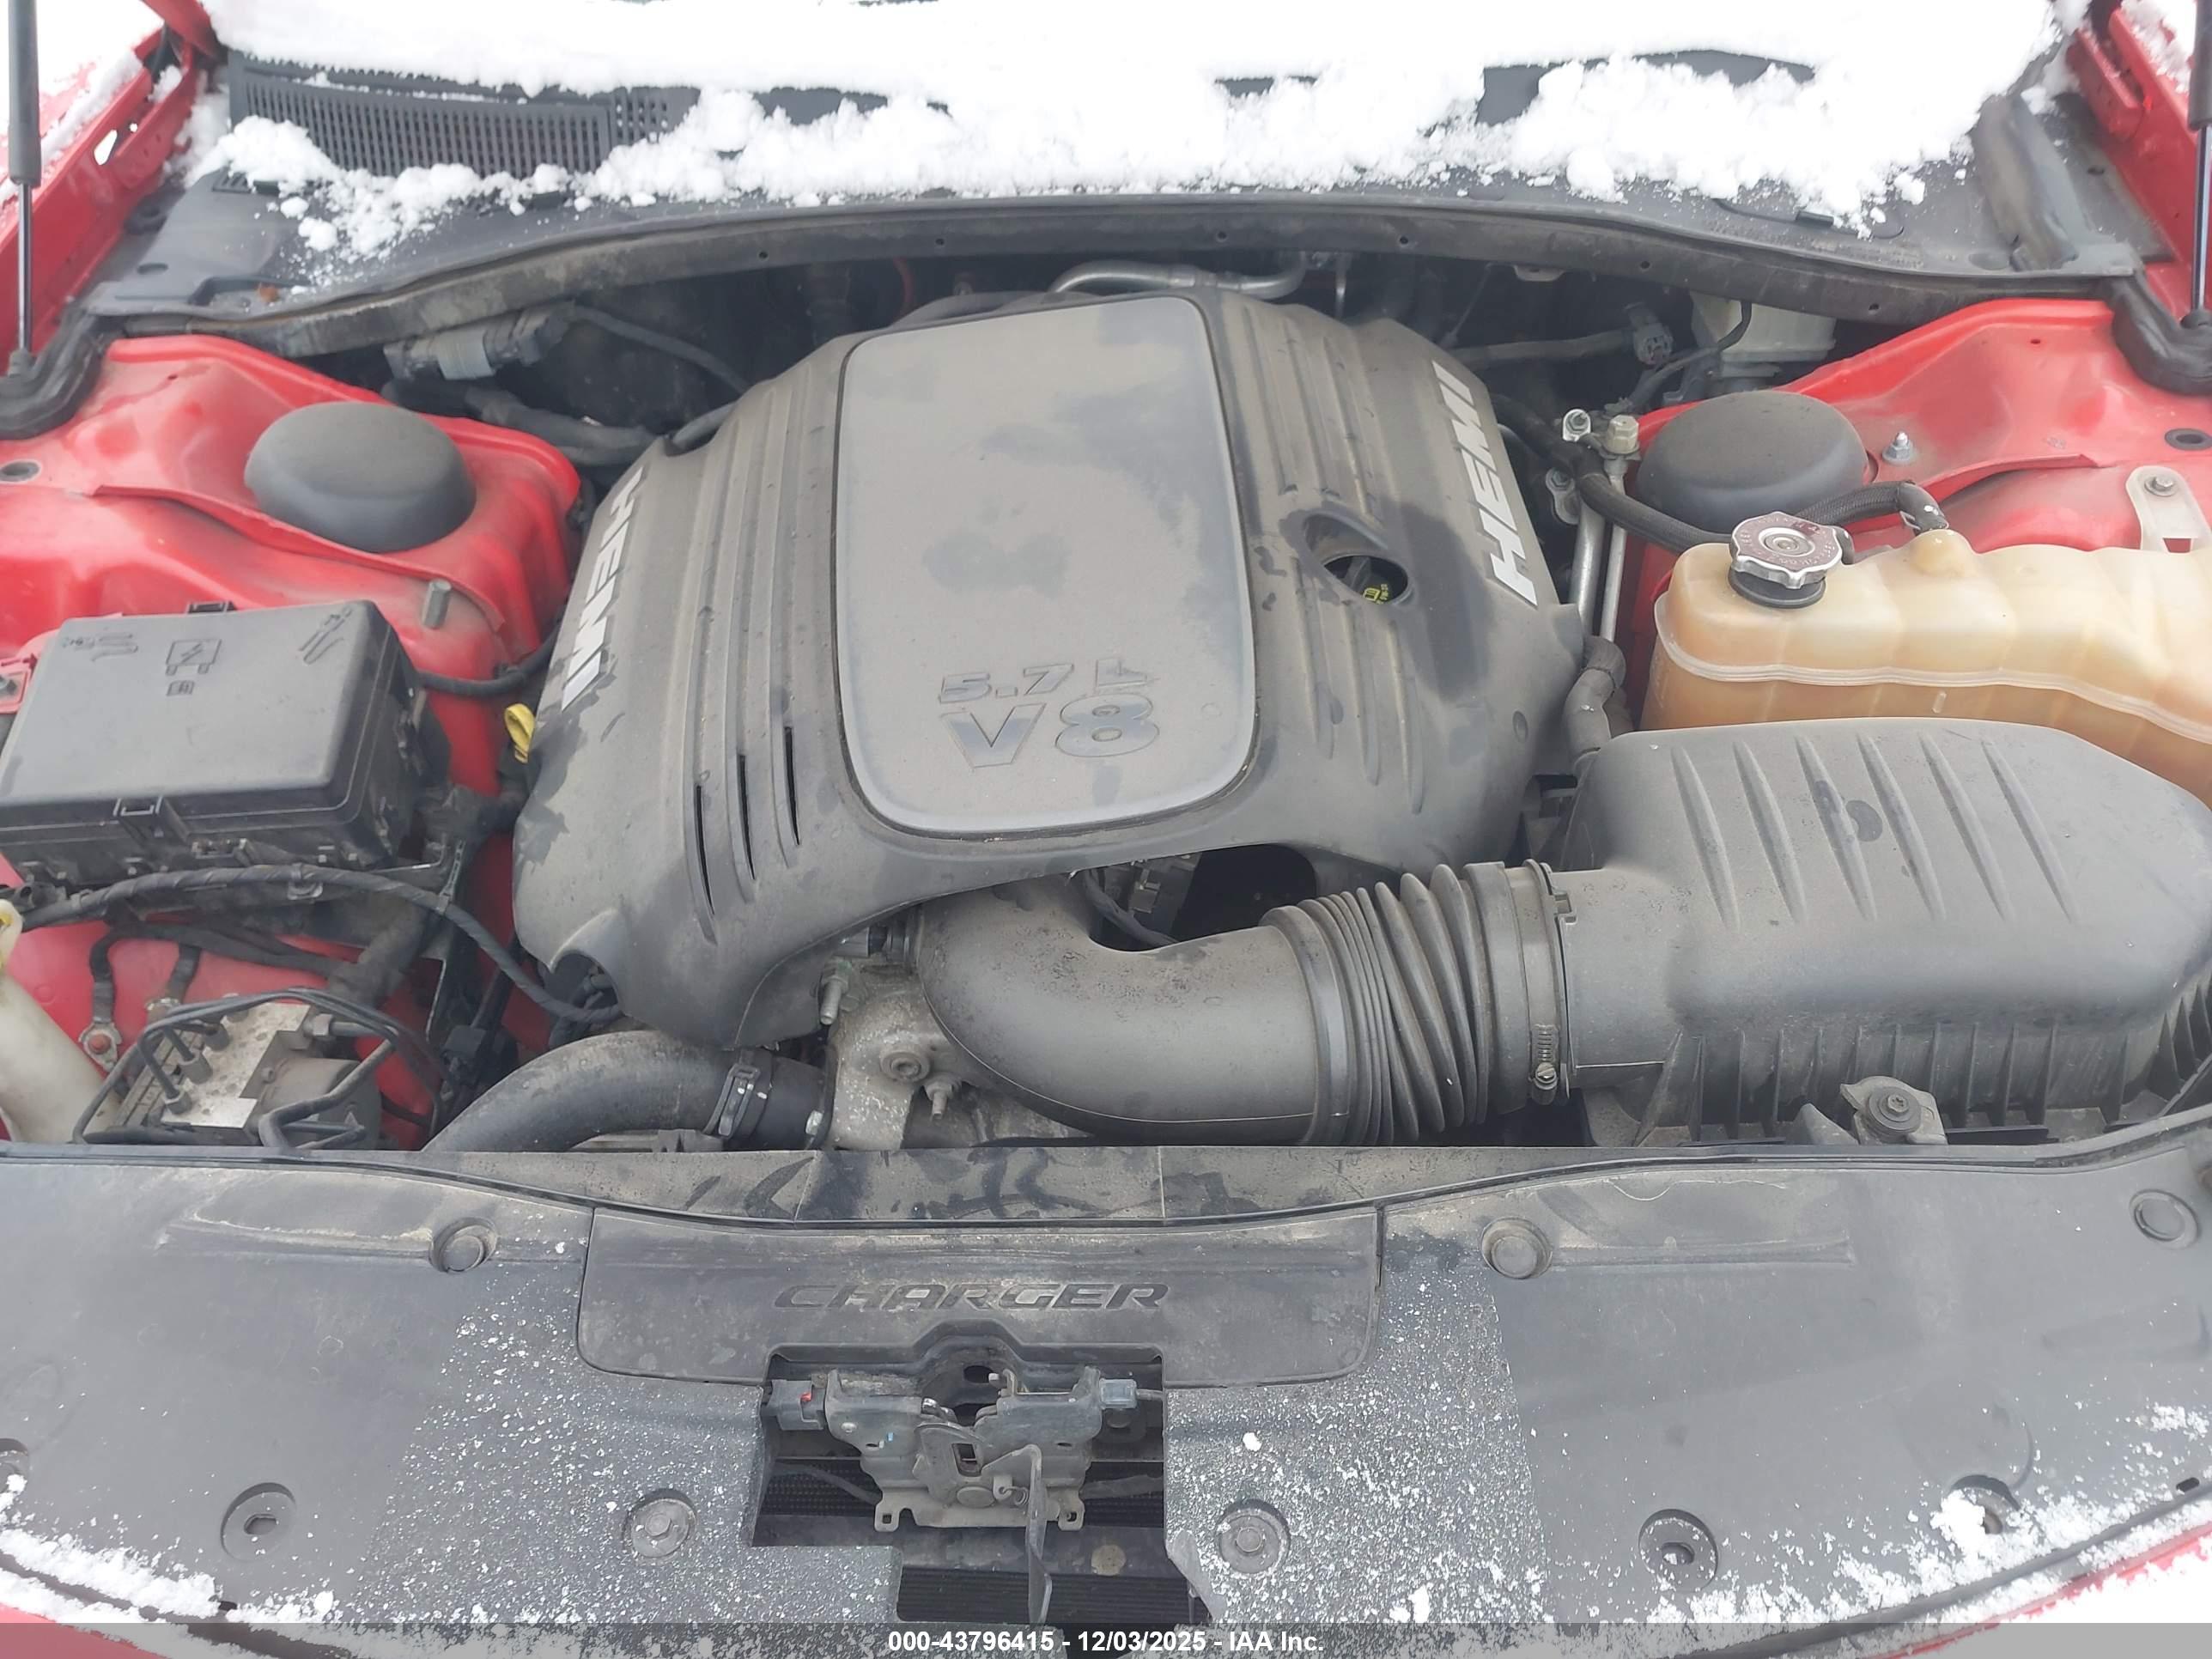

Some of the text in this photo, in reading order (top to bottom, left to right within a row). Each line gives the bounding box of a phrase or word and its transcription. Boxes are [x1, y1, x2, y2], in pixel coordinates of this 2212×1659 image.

[1432, 360, 1538, 606] HEMI
[561, 466, 643, 711] HEMI
[940, 692, 1160, 769] V8
[774, 1283, 1170, 1311] CHARGER
